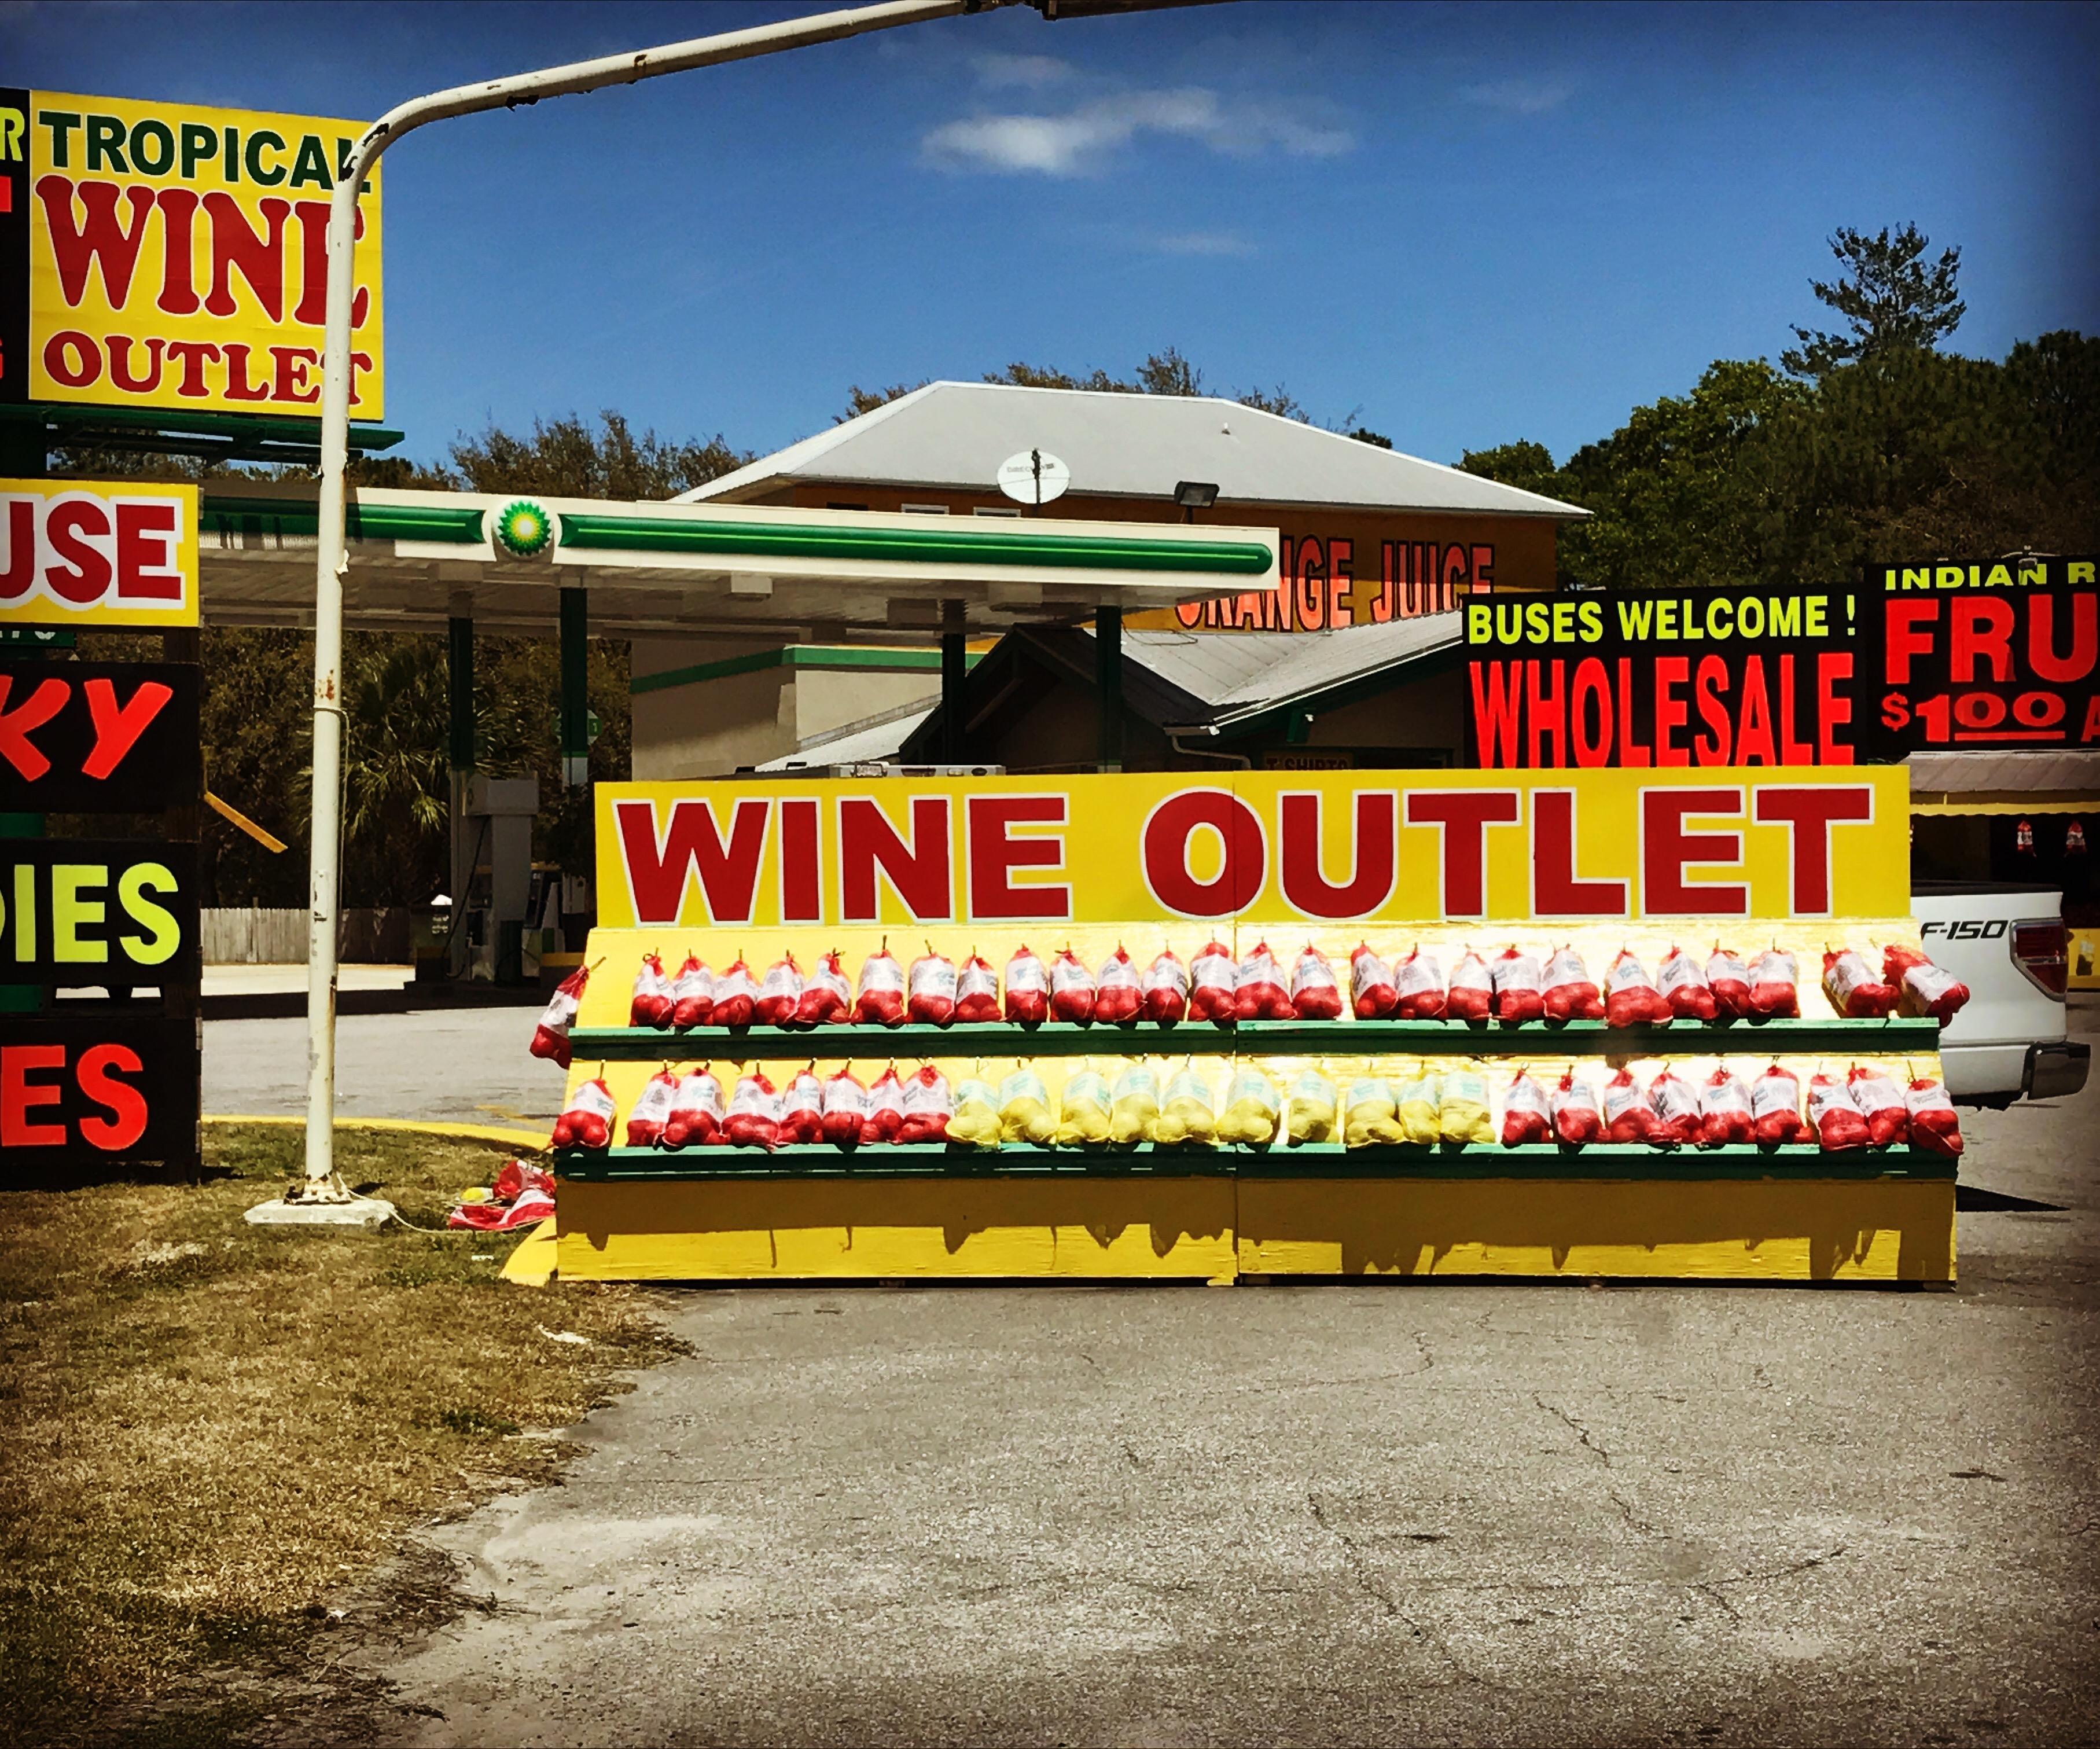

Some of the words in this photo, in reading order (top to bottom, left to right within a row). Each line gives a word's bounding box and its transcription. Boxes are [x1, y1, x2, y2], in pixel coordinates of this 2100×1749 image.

[38, 110, 371, 194] TROPICAL
[35, 175, 369, 329] WINE
[1370, 540, 1495, 624] JUICE
[1468, 600, 1603, 645] BUSES
[1617, 594, 1829, 641] WELCOME
[1885, 563, 2047, 591] INDIAN
[1885, 592, 2099, 685] FRU
[1469, 652, 1855, 769] WHOLESALE
[615, 796, 1071, 924] WINE
[1142, 786, 1872, 920] OUTLET
[0, 862, 181, 965] IES
[1920, 919, 2009, 940] F-150
